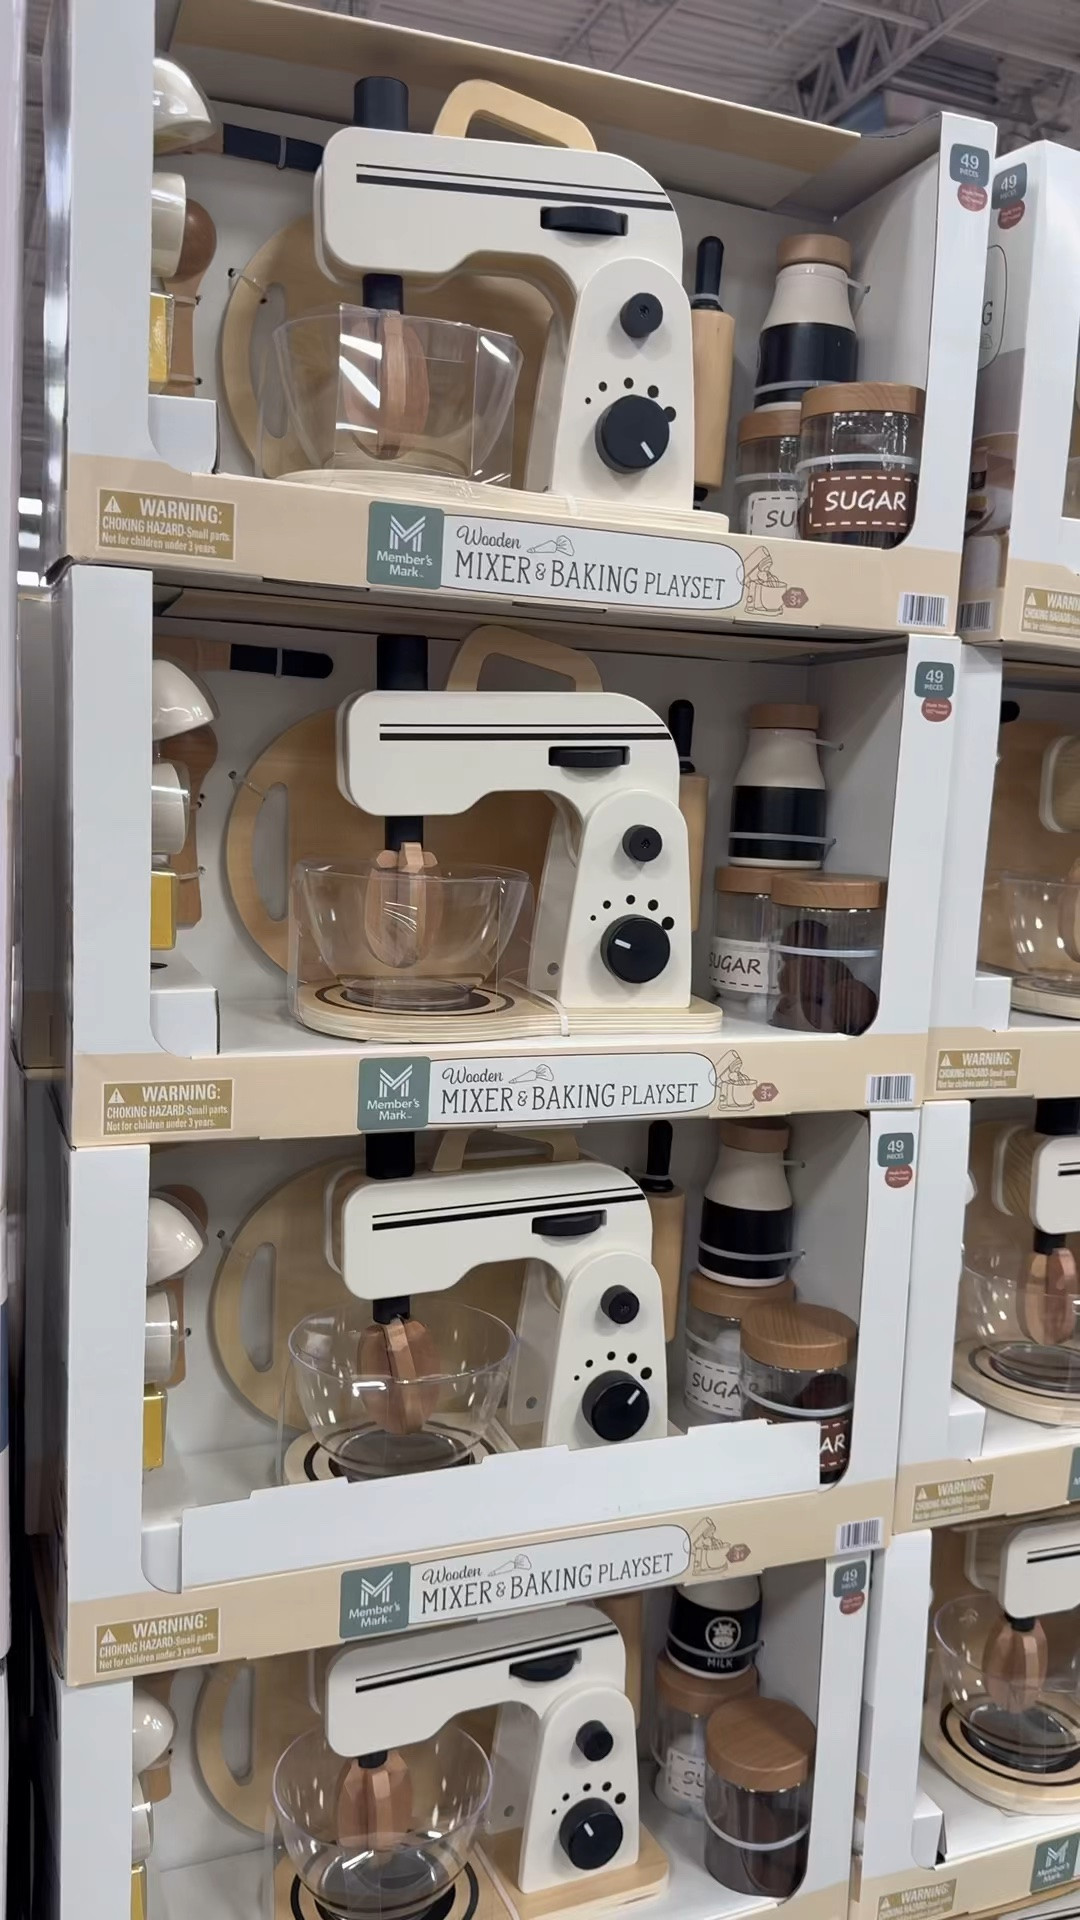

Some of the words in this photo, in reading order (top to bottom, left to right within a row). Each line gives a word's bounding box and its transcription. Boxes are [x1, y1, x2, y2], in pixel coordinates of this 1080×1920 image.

[960, 153, 979, 169] 49
[1001, 174, 1017, 191] 49
[824, 489, 907, 512] SUGAR
[139, 498, 223, 525] WARNING:
[102, 516, 145, 533] CHOKING
[102, 532, 117, 544] Not
[118, 533, 129, 545] for
[130, 535, 163, 549] children
[164, 538, 187, 551] under
[188, 540, 193, 552] 3
[456, 525, 521, 550] Wooden
[376, 550, 433, 567] Member's
[389, 563, 419, 578] Mark
[455, 550, 531, 584] MIXER
[535, 562, 547, 580] &
[550, 559, 638, 594] BAKING
[643, 571, 726, 601] PLAYSET
[925, 669, 944, 684] 49
[708, 951, 761, 975] SUGAR
[962, 1052, 1013, 1066] WARNING:
[441, 1066, 504, 1085] Wooden
[141, 1083, 221, 1102] WARNING:
[440, 1087, 513, 1114] MIXER
[517, 1090, 528, 1107] &
[532, 1083, 616, 1111] BAKING
[621, 1083, 699, 1106] PLAYSET
[106, 1105, 147, 1119] CHOKING
[366, 1098, 420, 1110] Member's
[379, 1107, 407, 1121] Mark
[106, 1121, 121, 1131] Not
[121, 1120, 132, 1131] for
[134, 1118, 165, 1130] children
[166, 1118, 187, 1129] under
[188, 1118, 193, 1128] 3
[887, 1139, 905, 1153] 49
[421, 1565, 481, 1585] Wooden
[421, 1580, 492, 1614] MIXER
[496, 1581, 507, 1598] &
[510, 1562, 592, 1600] BAKING
[598, 1552, 673, 1584] PLAYSET
[842, 1568, 858, 1583] 49
[348, 1600, 401, 1619] Member's
[132, 1613, 208, 1639] WARNING:
[360, 1613, 388, 1628] Mark
[99, 1641, 138, 1659] CHOKING
[99, 1658, 113, 1670] Not
[113, 1657, 124, 1668] for
[125, 1653, 155, 1666] children
[155, 1649, 176, 1662] under
[177, 1647, 182, 1657] 3
[706, 1657, 733, 1669] MILK
